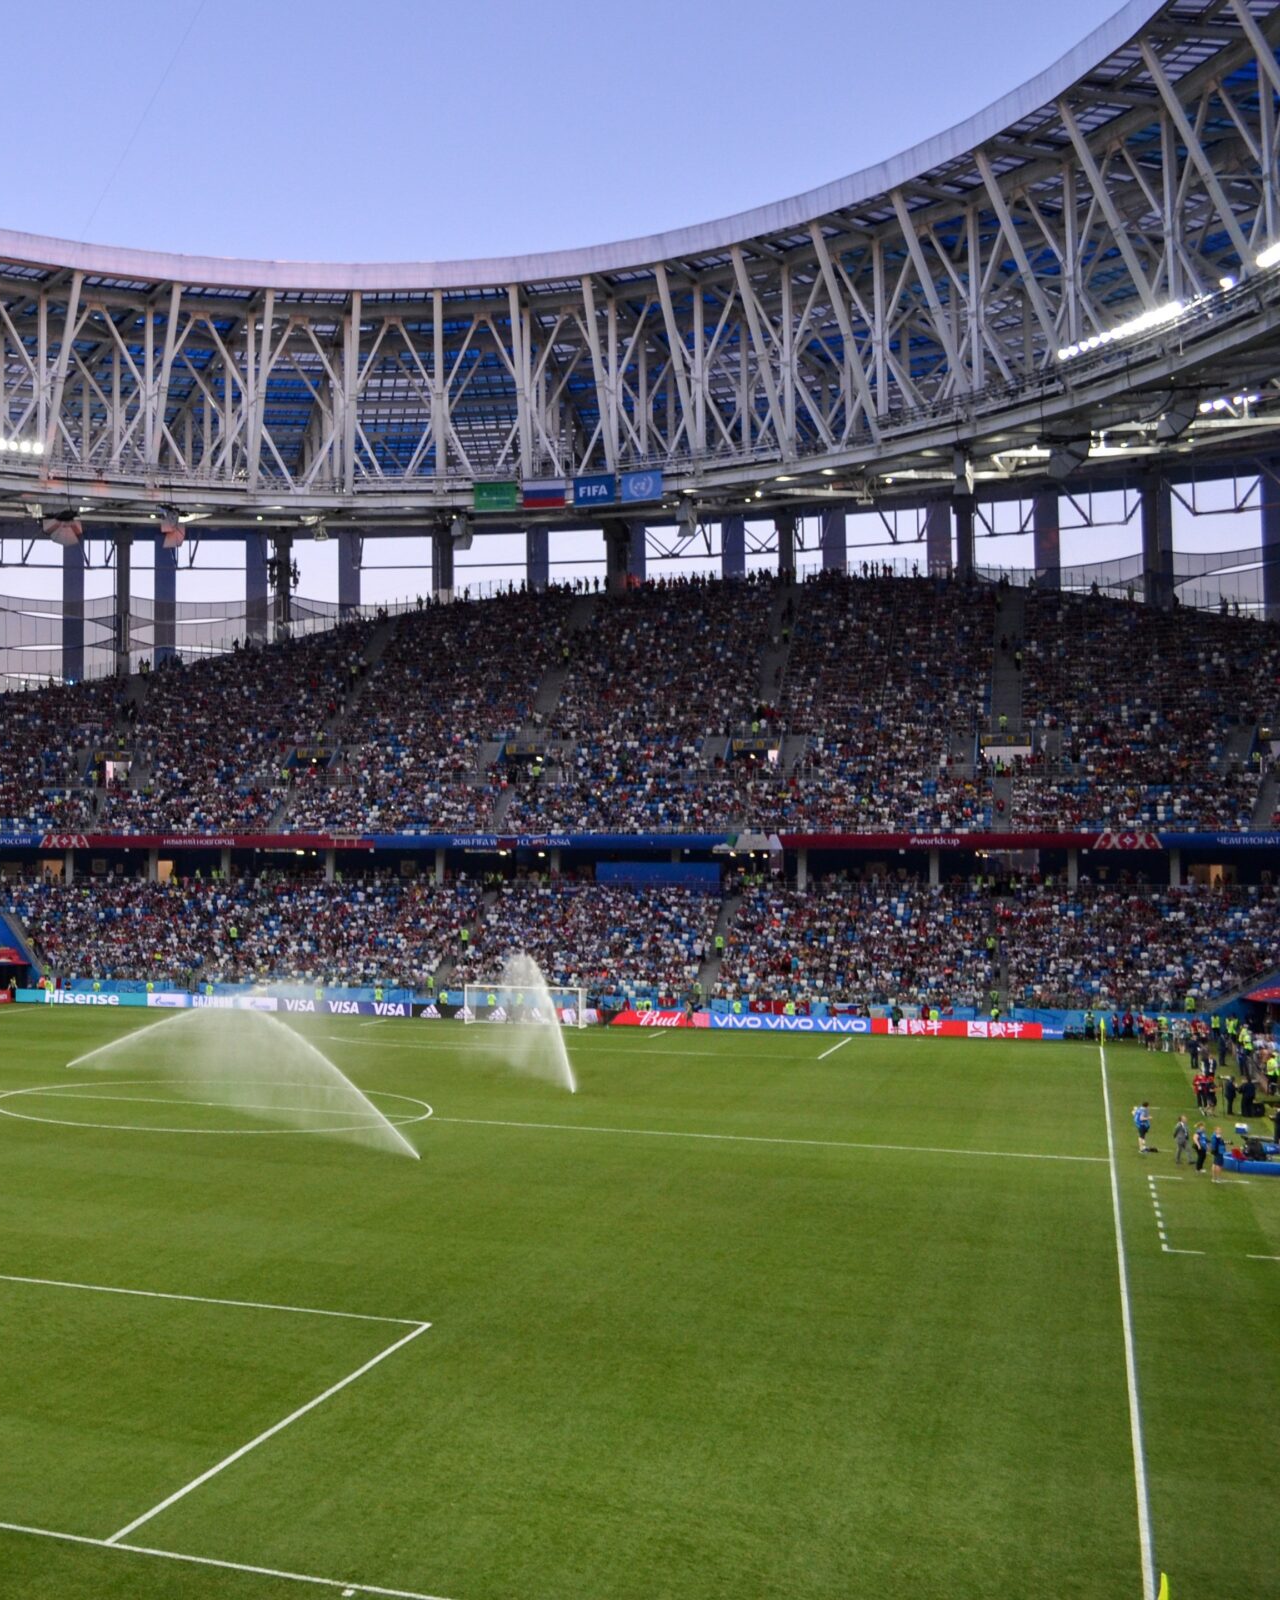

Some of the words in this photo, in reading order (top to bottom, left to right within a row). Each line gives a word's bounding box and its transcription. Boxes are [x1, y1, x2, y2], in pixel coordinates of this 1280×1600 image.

[579, 484, 608, 498] FIFA
[452, 838, 471, 846] 2018
[471, 838, 489, 846] FIFA
[544, 838, 571, 846] USSIA
[909, 836, 960, 847] #worldcup
[44, 990, 119, 1006] Hisense
[284, 998, 315, 1012] VISA
[328, 1000, 359, 1015] VISA
[372, 1002, 405, 1017] VISA
[636, 1010, 682, 1027] Bud
